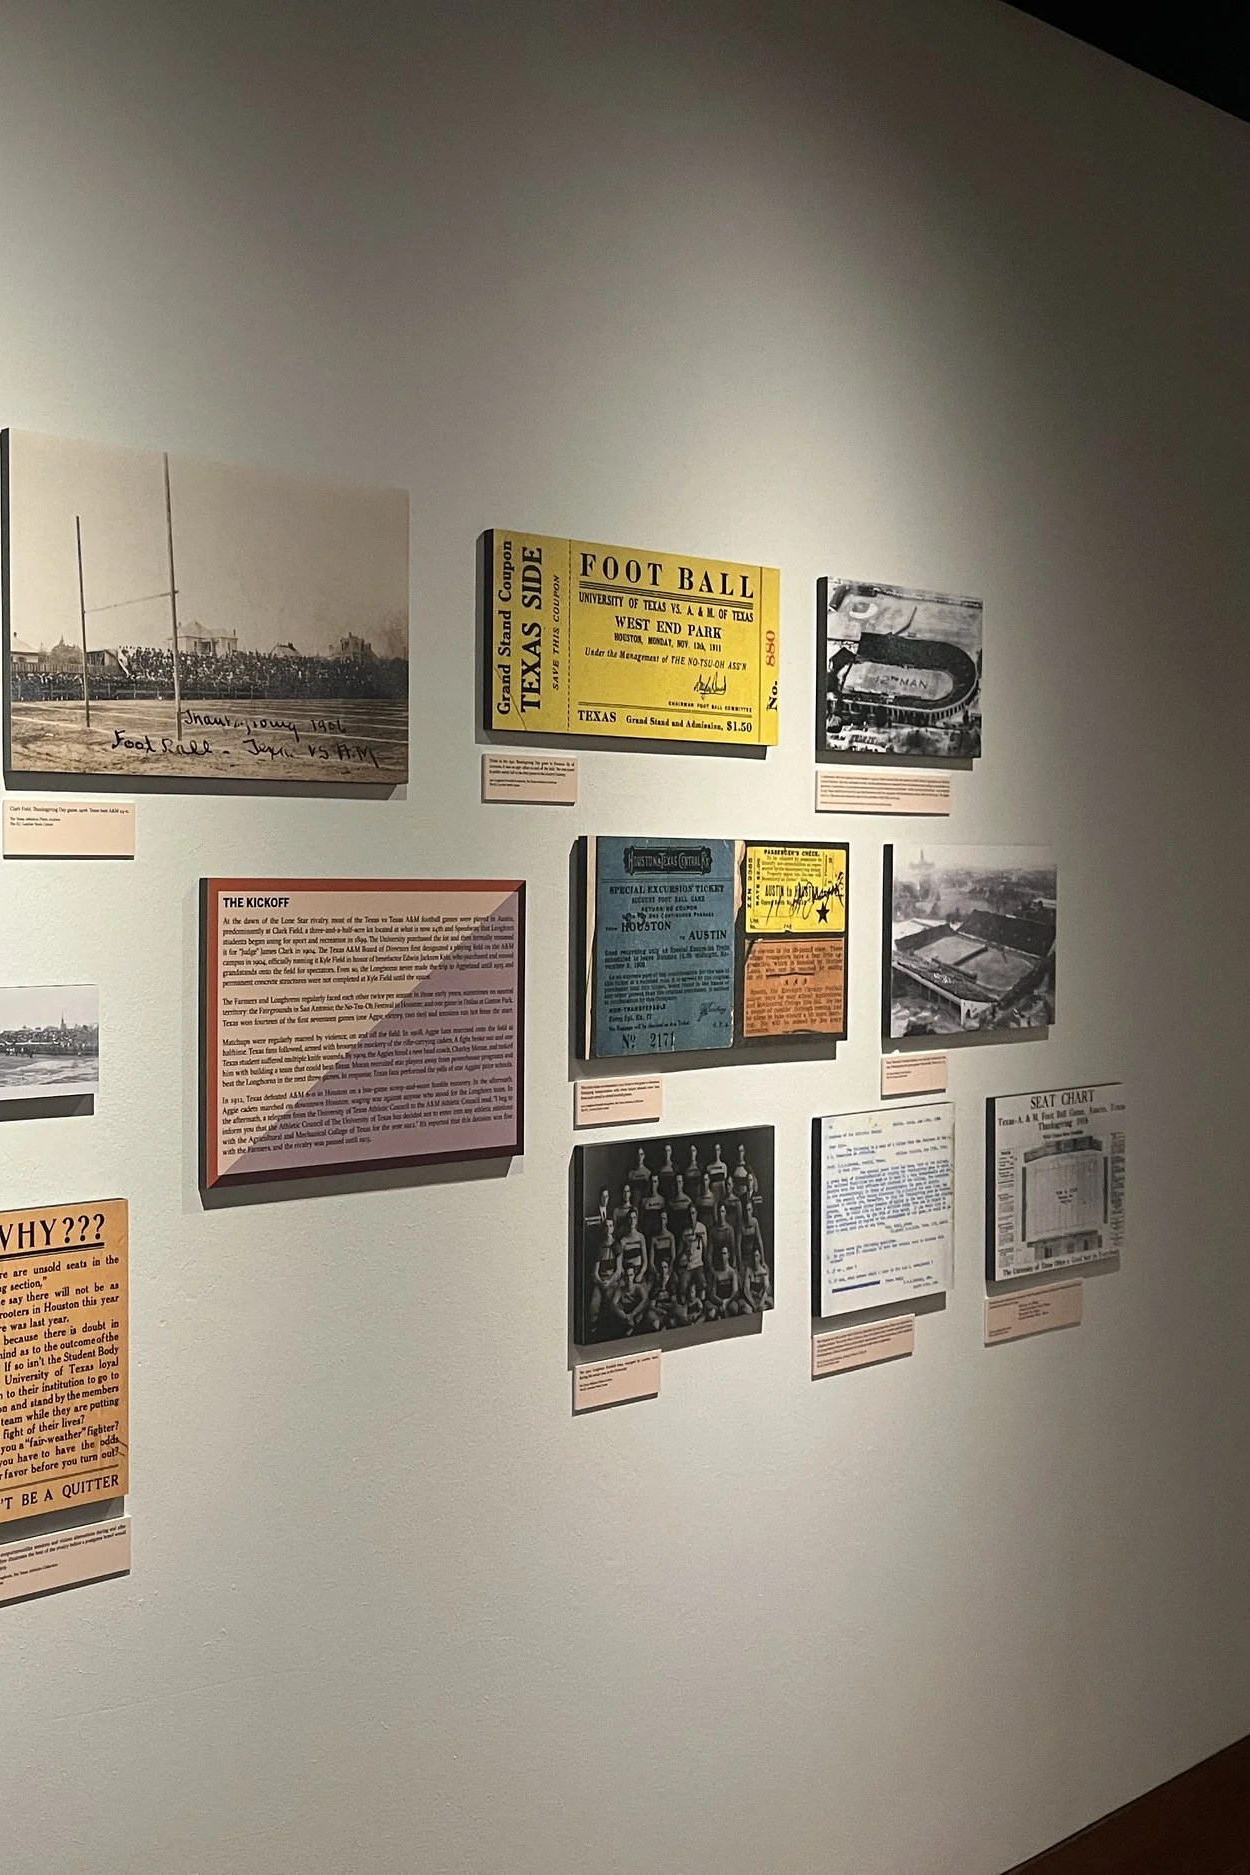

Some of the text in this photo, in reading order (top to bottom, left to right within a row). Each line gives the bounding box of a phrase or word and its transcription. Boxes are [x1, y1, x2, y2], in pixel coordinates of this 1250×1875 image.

[579, 553, 753, 598] FOOT BALL
[553, 575, 561, 621] COUPON
[579, 592, 753, 622] UNIVERSITY OF TEXAS VS. A. & M. OF TEXAS
[497, 541, 514, 714] Grand Stand Coupon
[521, 547, 542, 712] TEXAS SIDE
[552, 625, 560, 653] THIS
[615, 616, 721, 639] WEST END PARK
[585, 647, 746, 670] Under the Management of THE NO-TSU-OH ASS'N
[765, 630, 776, 667] 880
[578, 710, 616, 722] TEXAS
[626, 715, 647, 724] Grand
[650, 717, 669, 726] Stand
[727, 721, 752, 732] $1.50
[609, 884, 725, 895] SPECIAL EXCURSION TICKET
[223, 898, 289, 908] THE KICKOFF
[621, 921, 672, 933] HOUSTON
[688, 929, 727, 941] AUSTIN
[650, 1032, 675, 1048] 2171
[1030, 1089, 1095, 1110] SEAT CHART
[34, 1261, 60, 1274] unsold
[67, 1260, 87, 1269] seats
[93, 1257, 100, 1266] in
[106, 1255, 118, 1264] the
[9, 1296, 23, 1305] say
[27, 1292, 48, 1302] there
[55, 1286, 69, 1297] will
[76, 1286, 88, 1294] not
[95, 1282, 104, 1292] be
[22, 1491, 38, 1506] BE
[44, 1489, 53, 1501] A
[62, 1474, 118, 1498] QUITTER
